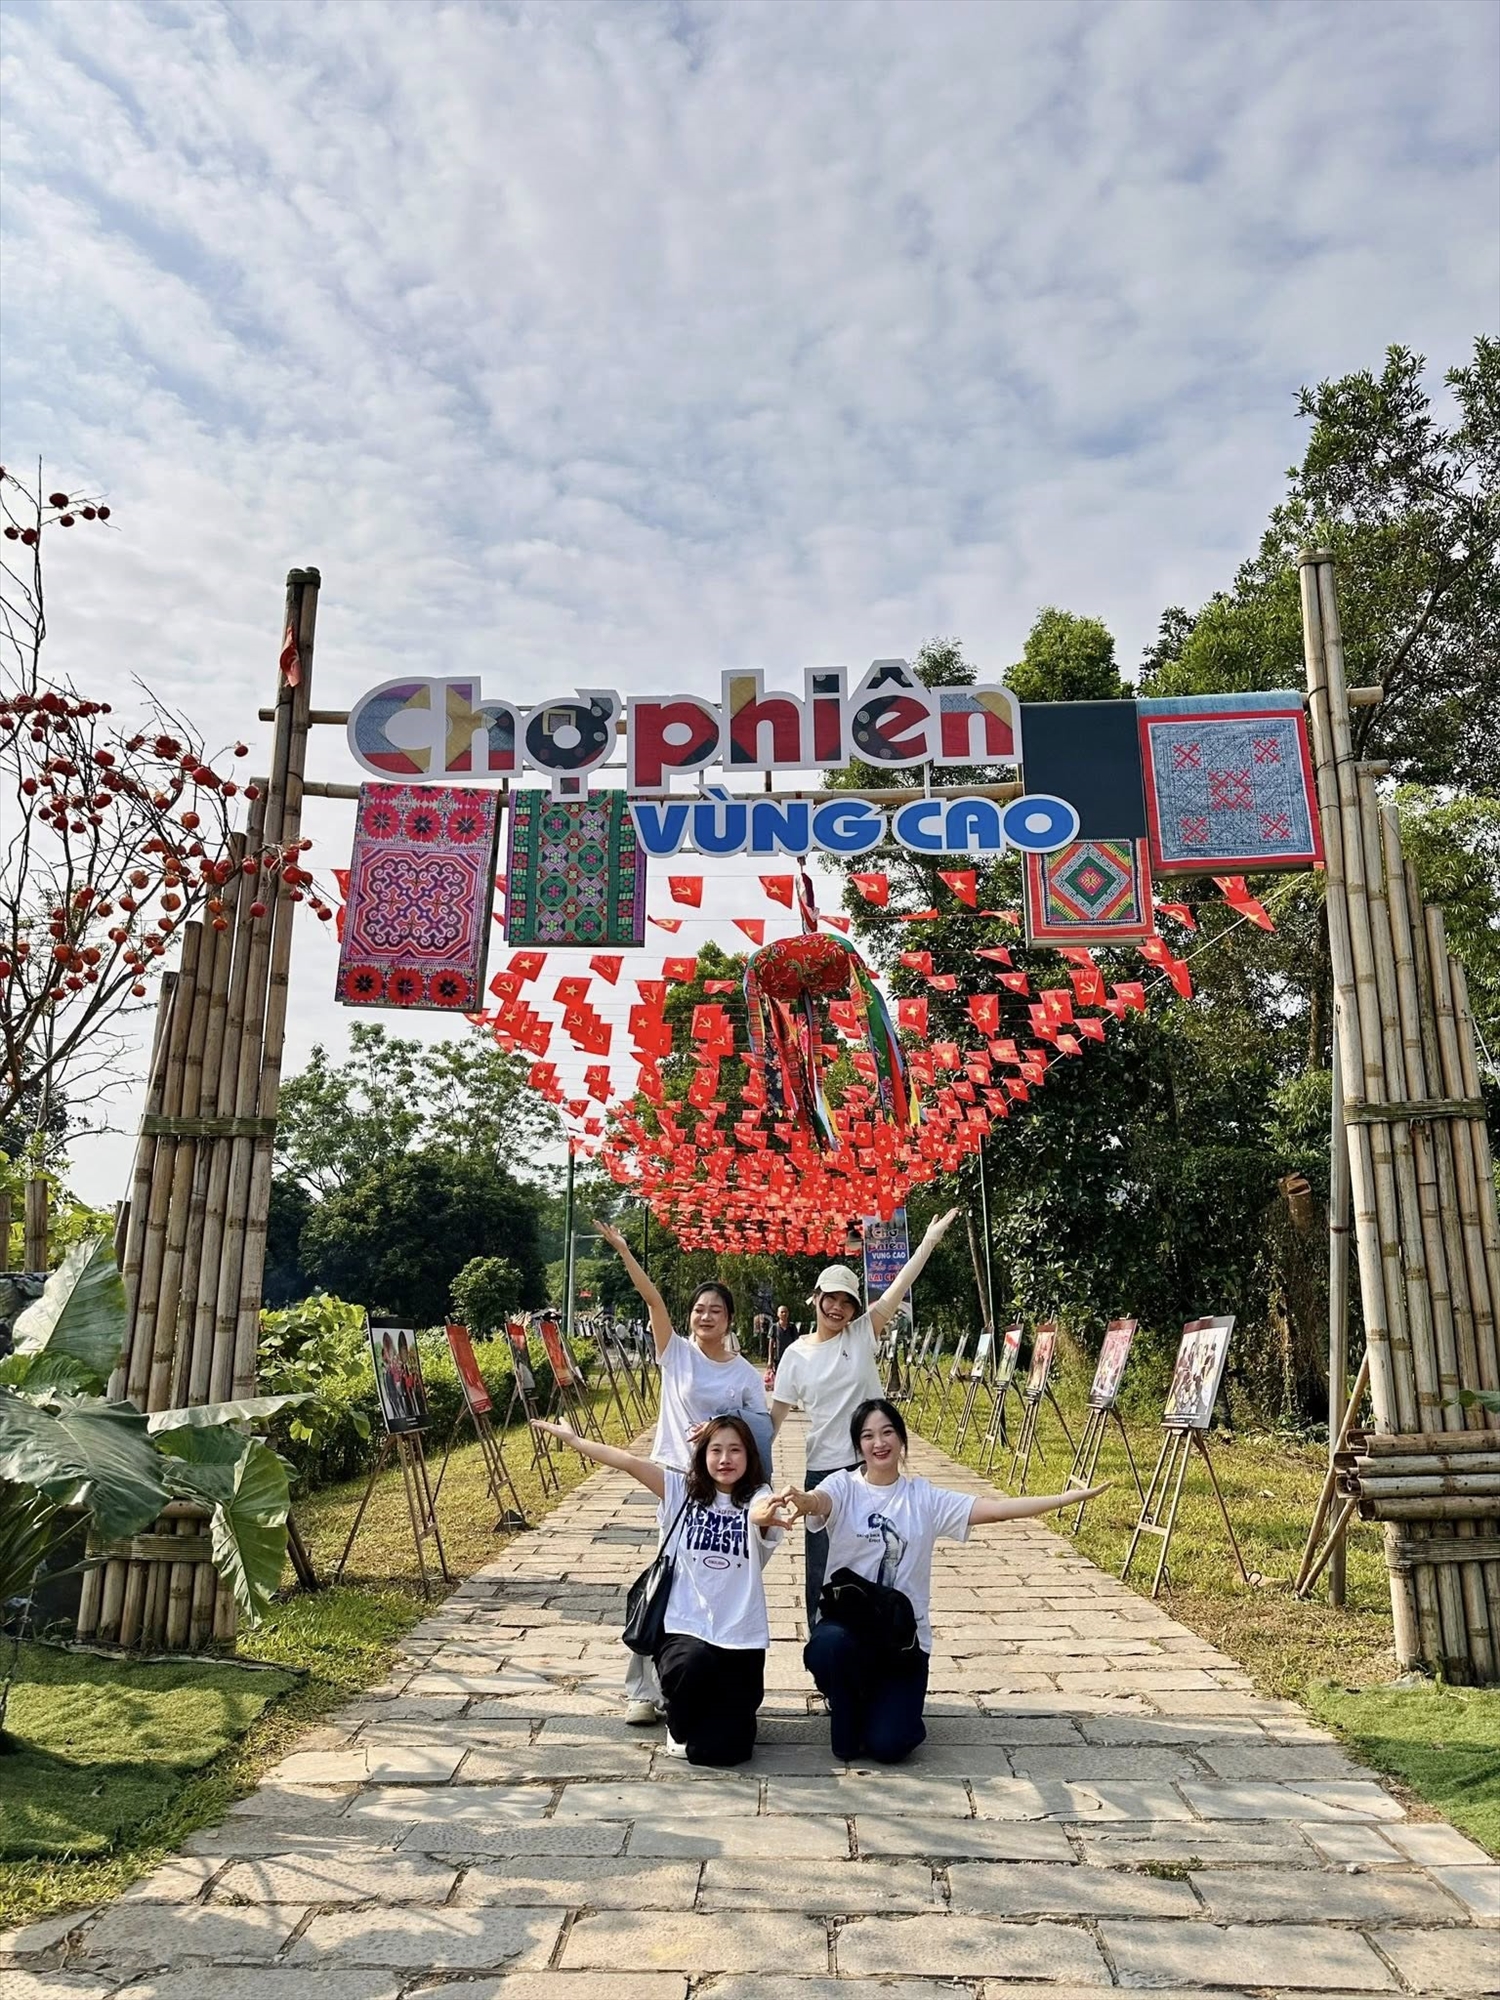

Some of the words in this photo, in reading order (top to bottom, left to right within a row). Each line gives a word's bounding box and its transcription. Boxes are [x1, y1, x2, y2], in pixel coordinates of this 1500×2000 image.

[351, 678, 618, 798] Chợ
[632, 662, 1019, 791] phiên
[634, 787, 884, 855] VÙNG
[896, 798, 1077, 853] CAO
[892, 1251, 906, 1259] CAO
[868, 1273, 883, 1282] LAI
